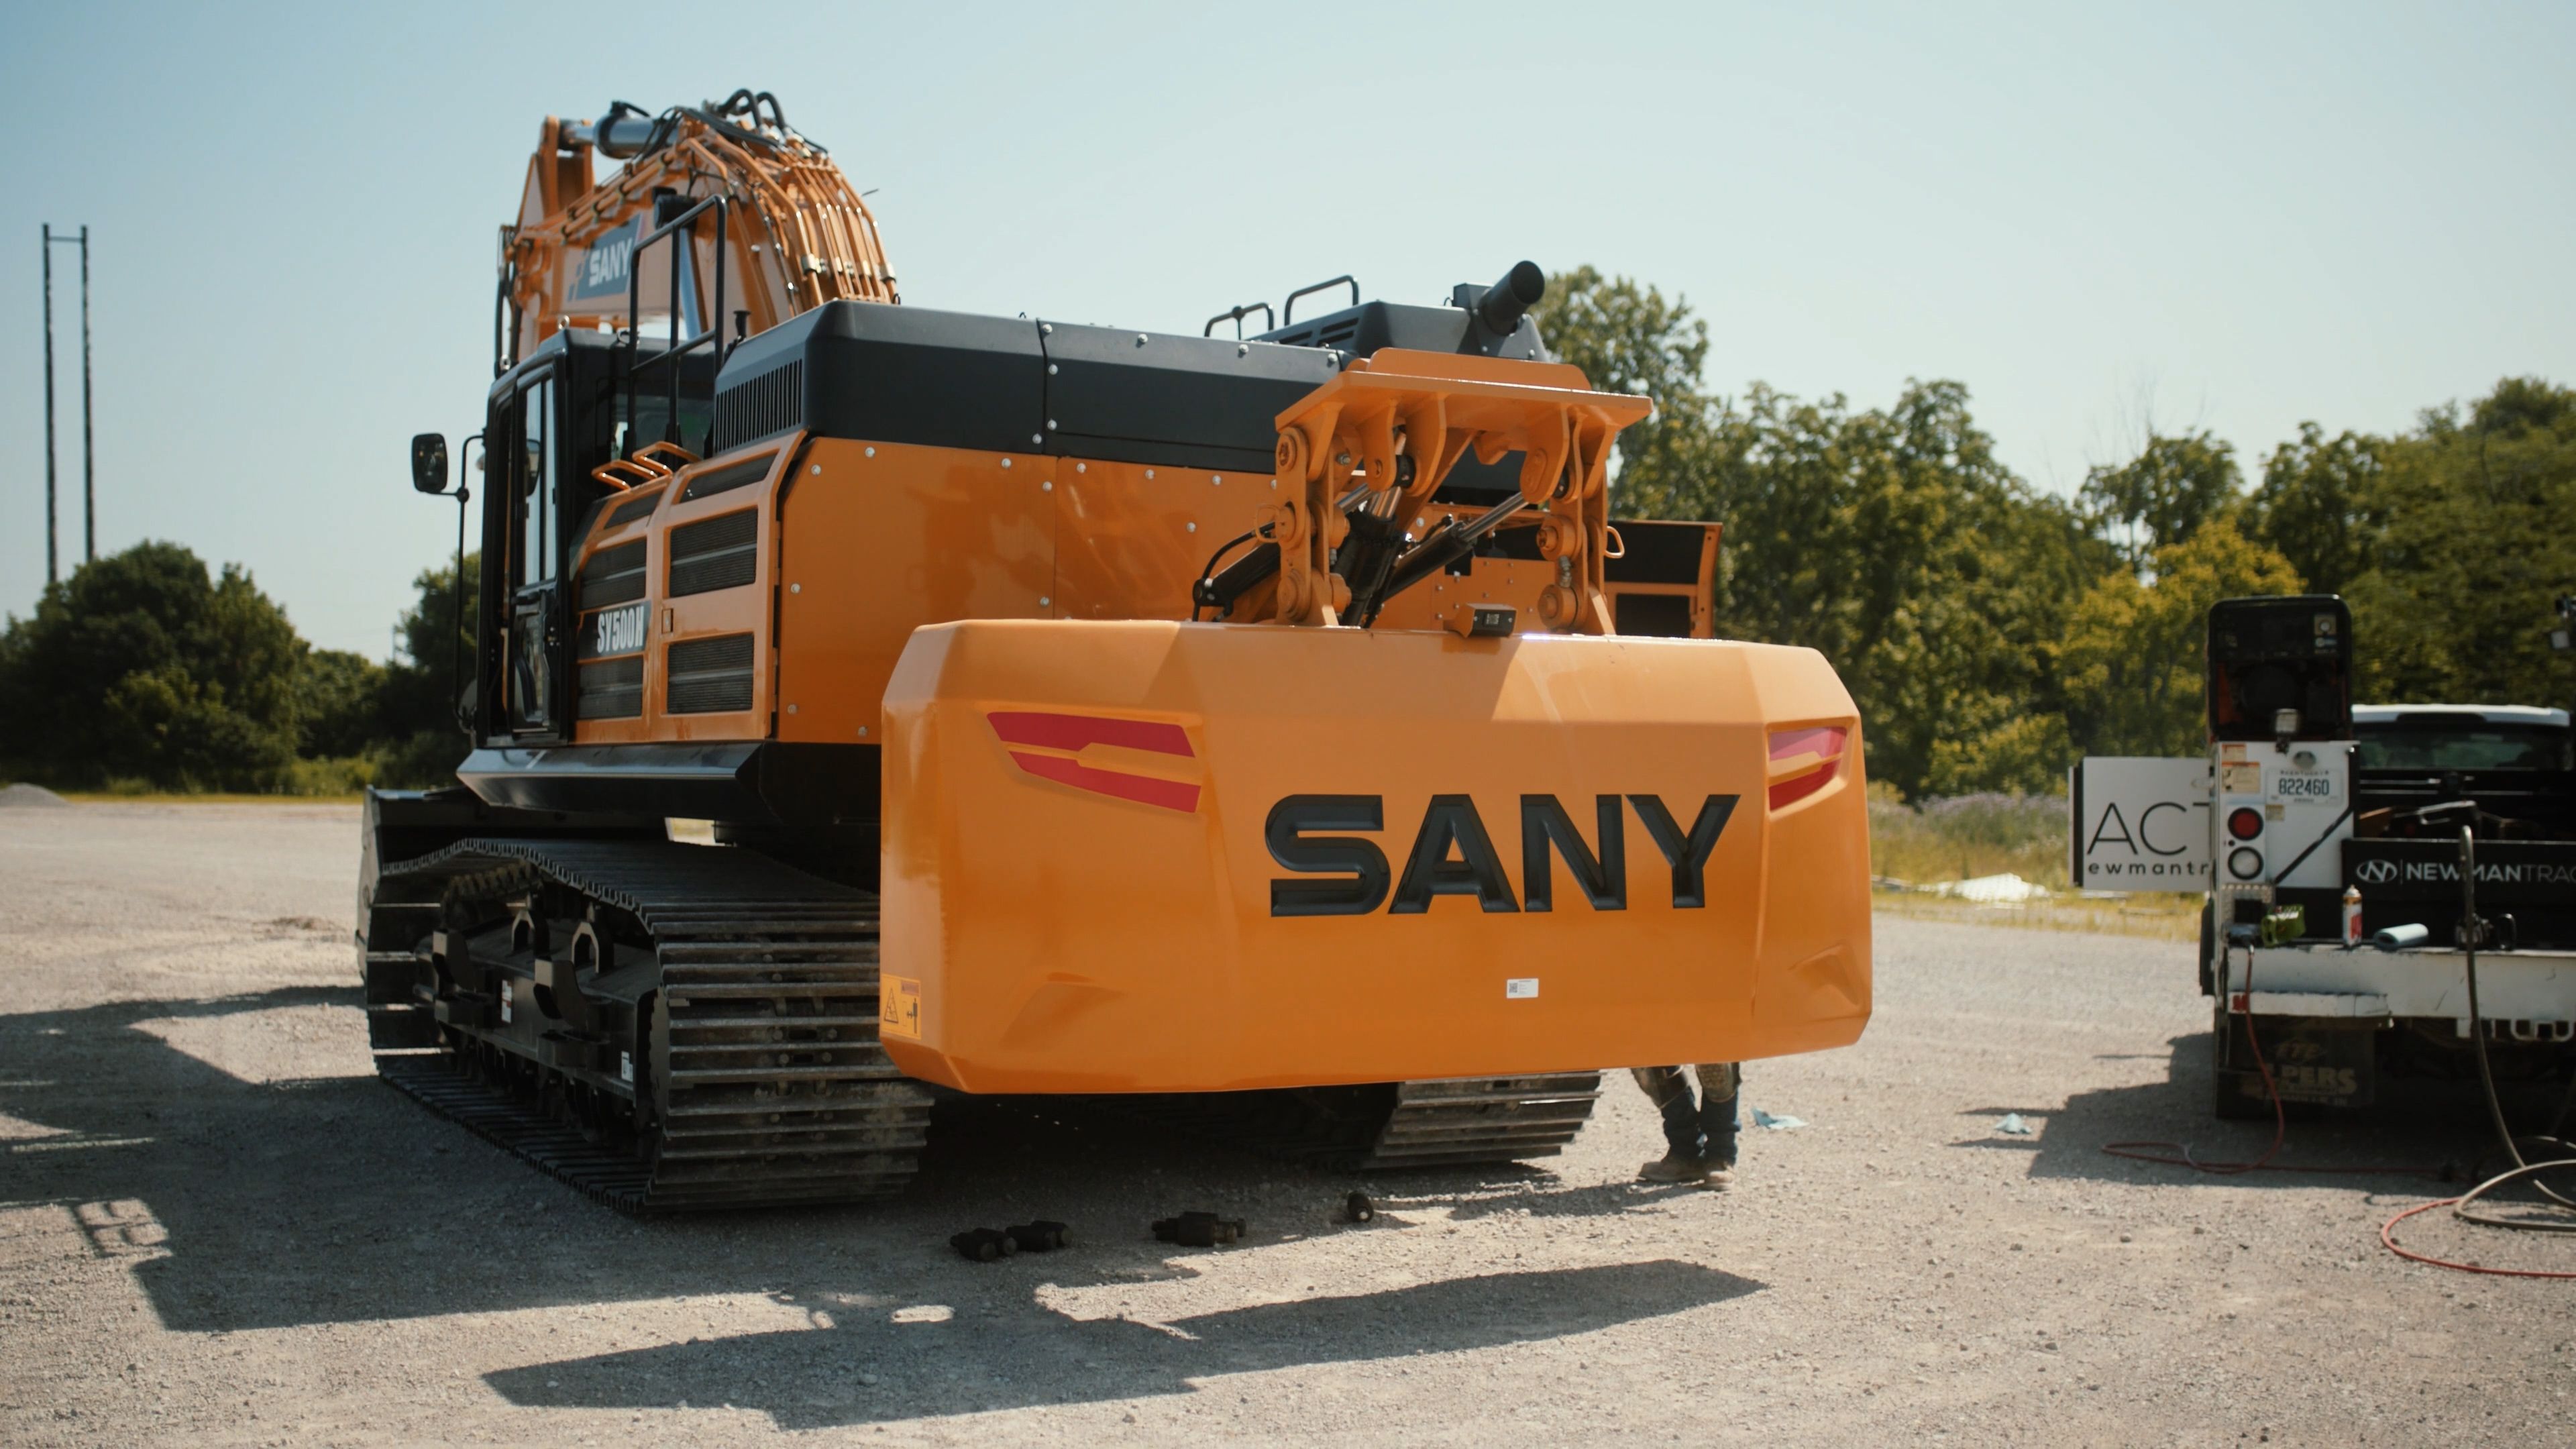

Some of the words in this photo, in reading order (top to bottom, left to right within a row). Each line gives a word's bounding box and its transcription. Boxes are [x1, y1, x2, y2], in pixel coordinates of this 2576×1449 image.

[589, 237, 633, 287] SANY
[597, 606, 644, 653] SY500H
[2279, 778, 2329, 796] 822460
[1265, 794, 1741, 917] SANY
